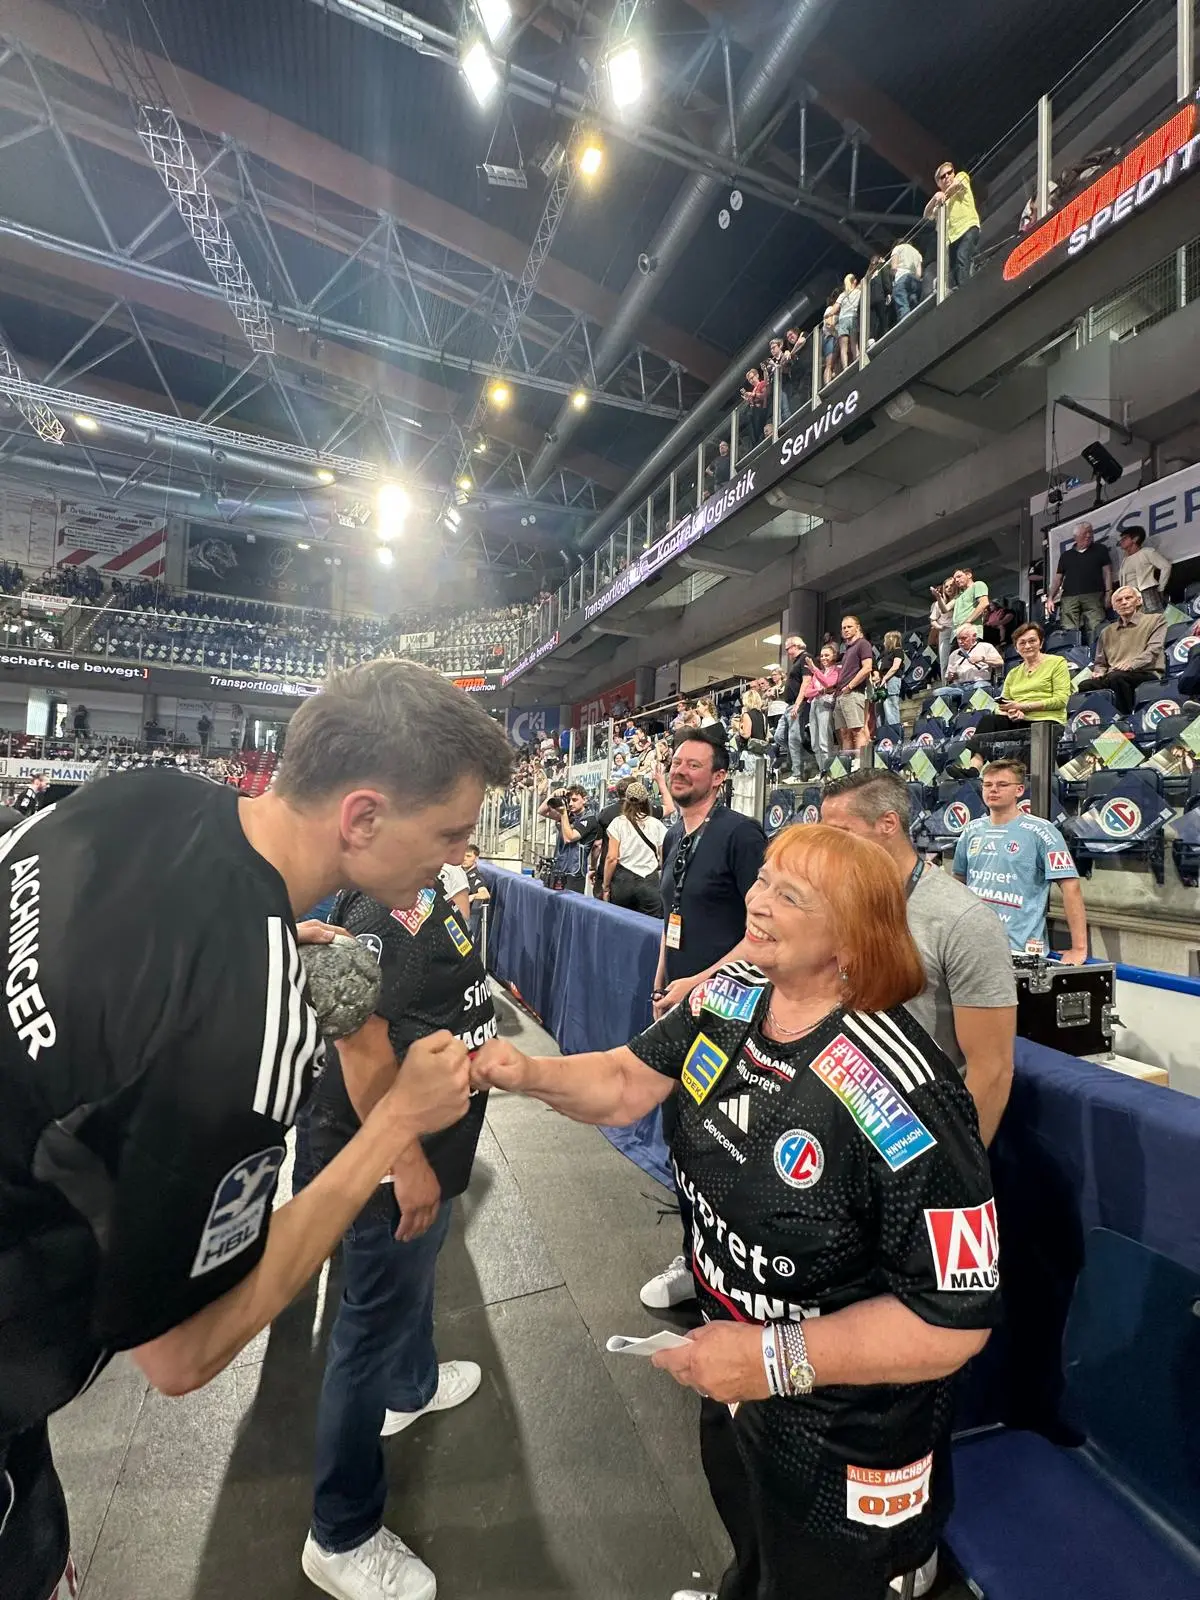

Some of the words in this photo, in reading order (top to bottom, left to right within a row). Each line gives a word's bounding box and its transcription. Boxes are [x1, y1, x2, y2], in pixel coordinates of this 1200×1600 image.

[779, 388, 859, 467] Service
[0, 655, 55, 669] schaft,
[58, 660, 80, 670] die
[84, 662, 149, 678] bewegt.]
[465, 684, 496, 692] SPEDITION
[6, 854, 57, 1061] AICHINGER
[682, 1071, 704, 1099] EDEKA
[819, 1055, 891, 1136] GEWINNT
[830, 1042, 908, 1123] #VIELFALT
[703, 1118, 747, 1165] devicenow
[885, 1127, 924, 1157] HOFMANN
[201, 1224, 256, 1267] HBL
[950, 1268, 998, 1289] MAU
[849, 1468, 881, 1483] ALLES
[858, 1488, 924, 1517] OBI
